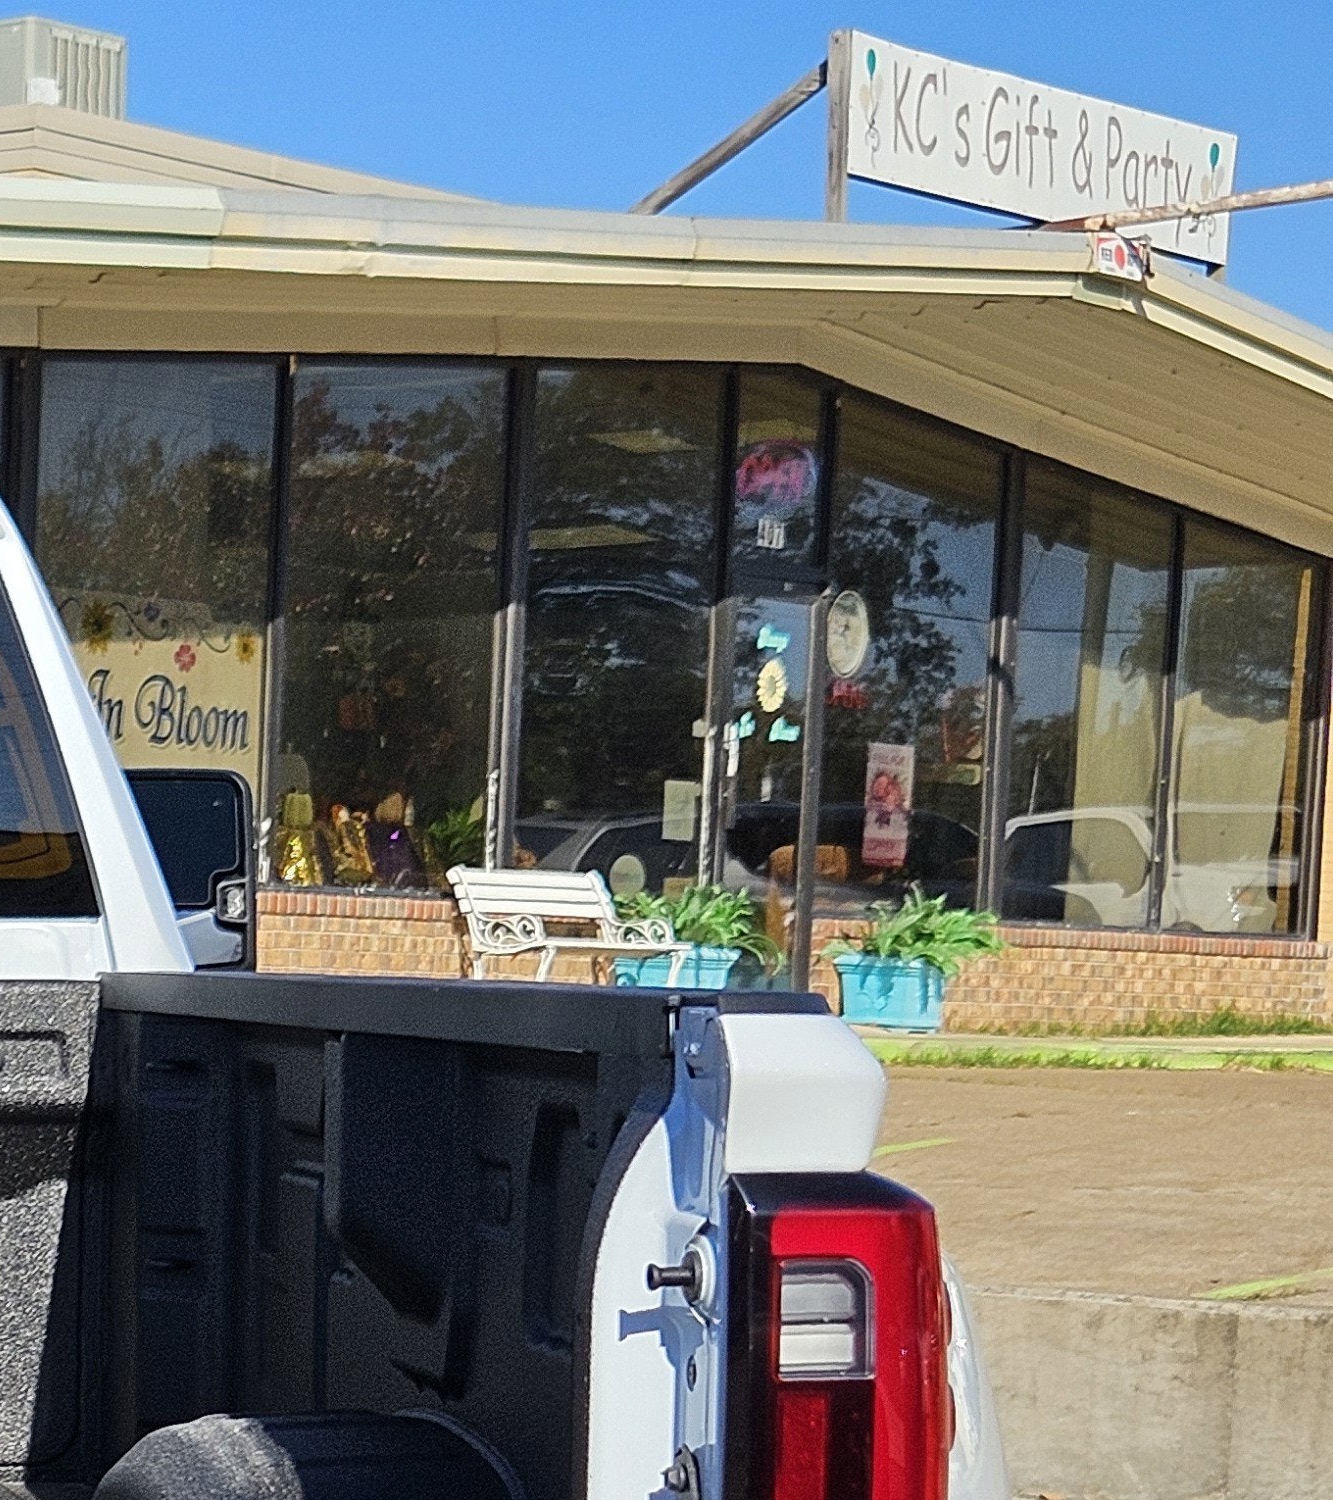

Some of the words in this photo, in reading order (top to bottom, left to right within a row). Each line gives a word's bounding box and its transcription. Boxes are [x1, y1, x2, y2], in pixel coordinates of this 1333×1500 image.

[893, 60, 970, 168] KC's
[985, 86, 1058, 189] Gift
[1072, 110, 1093, 199] &
[1106, 115, 1192, 247] Party
[135, 674, 250, 751] Bloom
